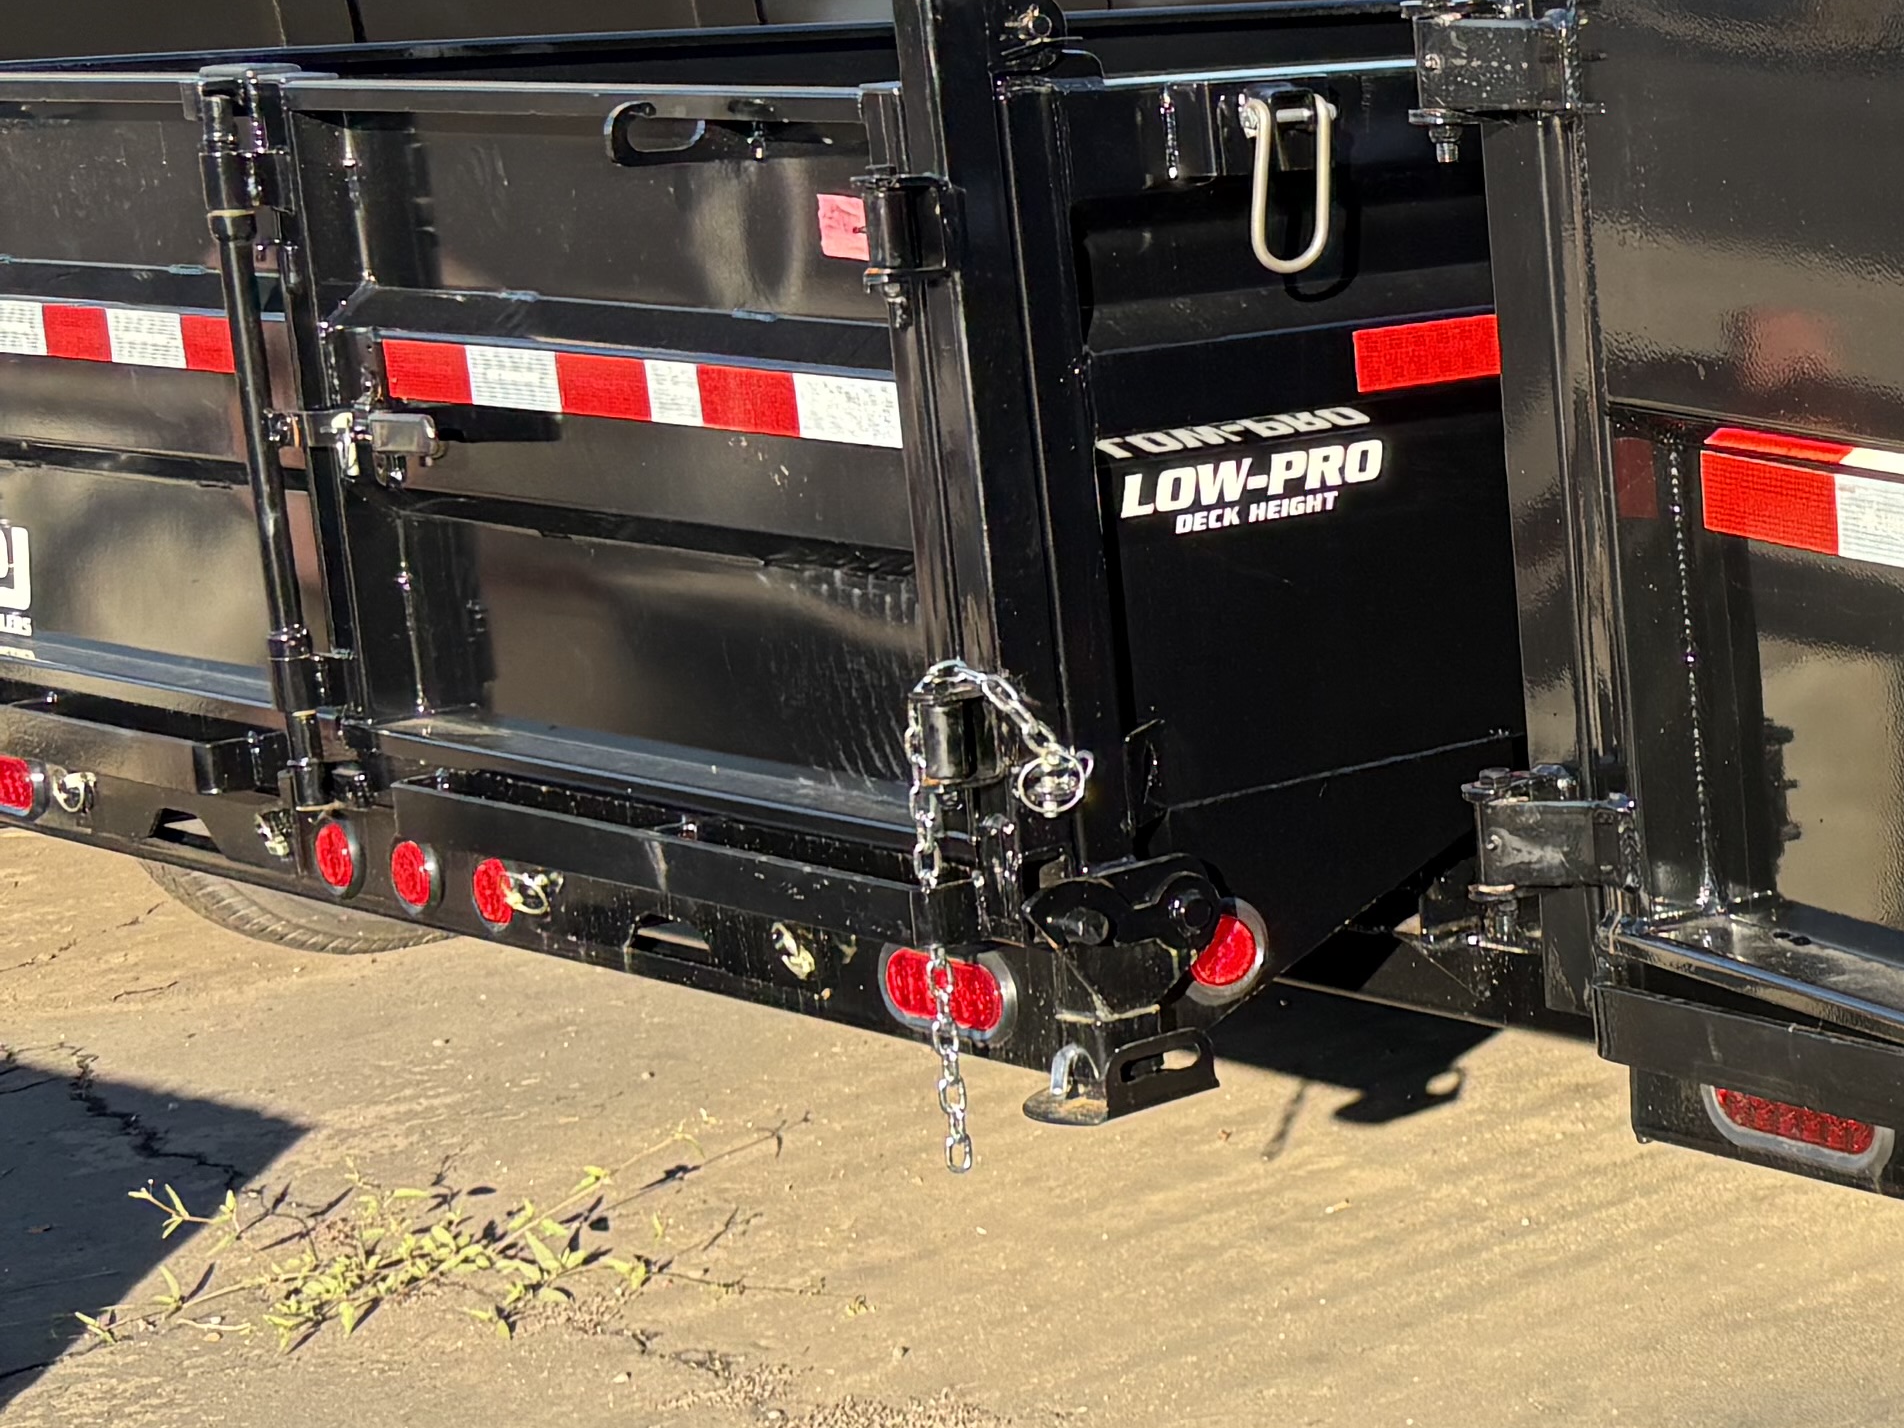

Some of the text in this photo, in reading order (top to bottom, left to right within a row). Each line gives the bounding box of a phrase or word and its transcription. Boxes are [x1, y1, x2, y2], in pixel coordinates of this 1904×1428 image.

[1120, 439, 1383, 519] LOW-PRO
[1175, 491, 1339, 535] DECK HEIGHT
